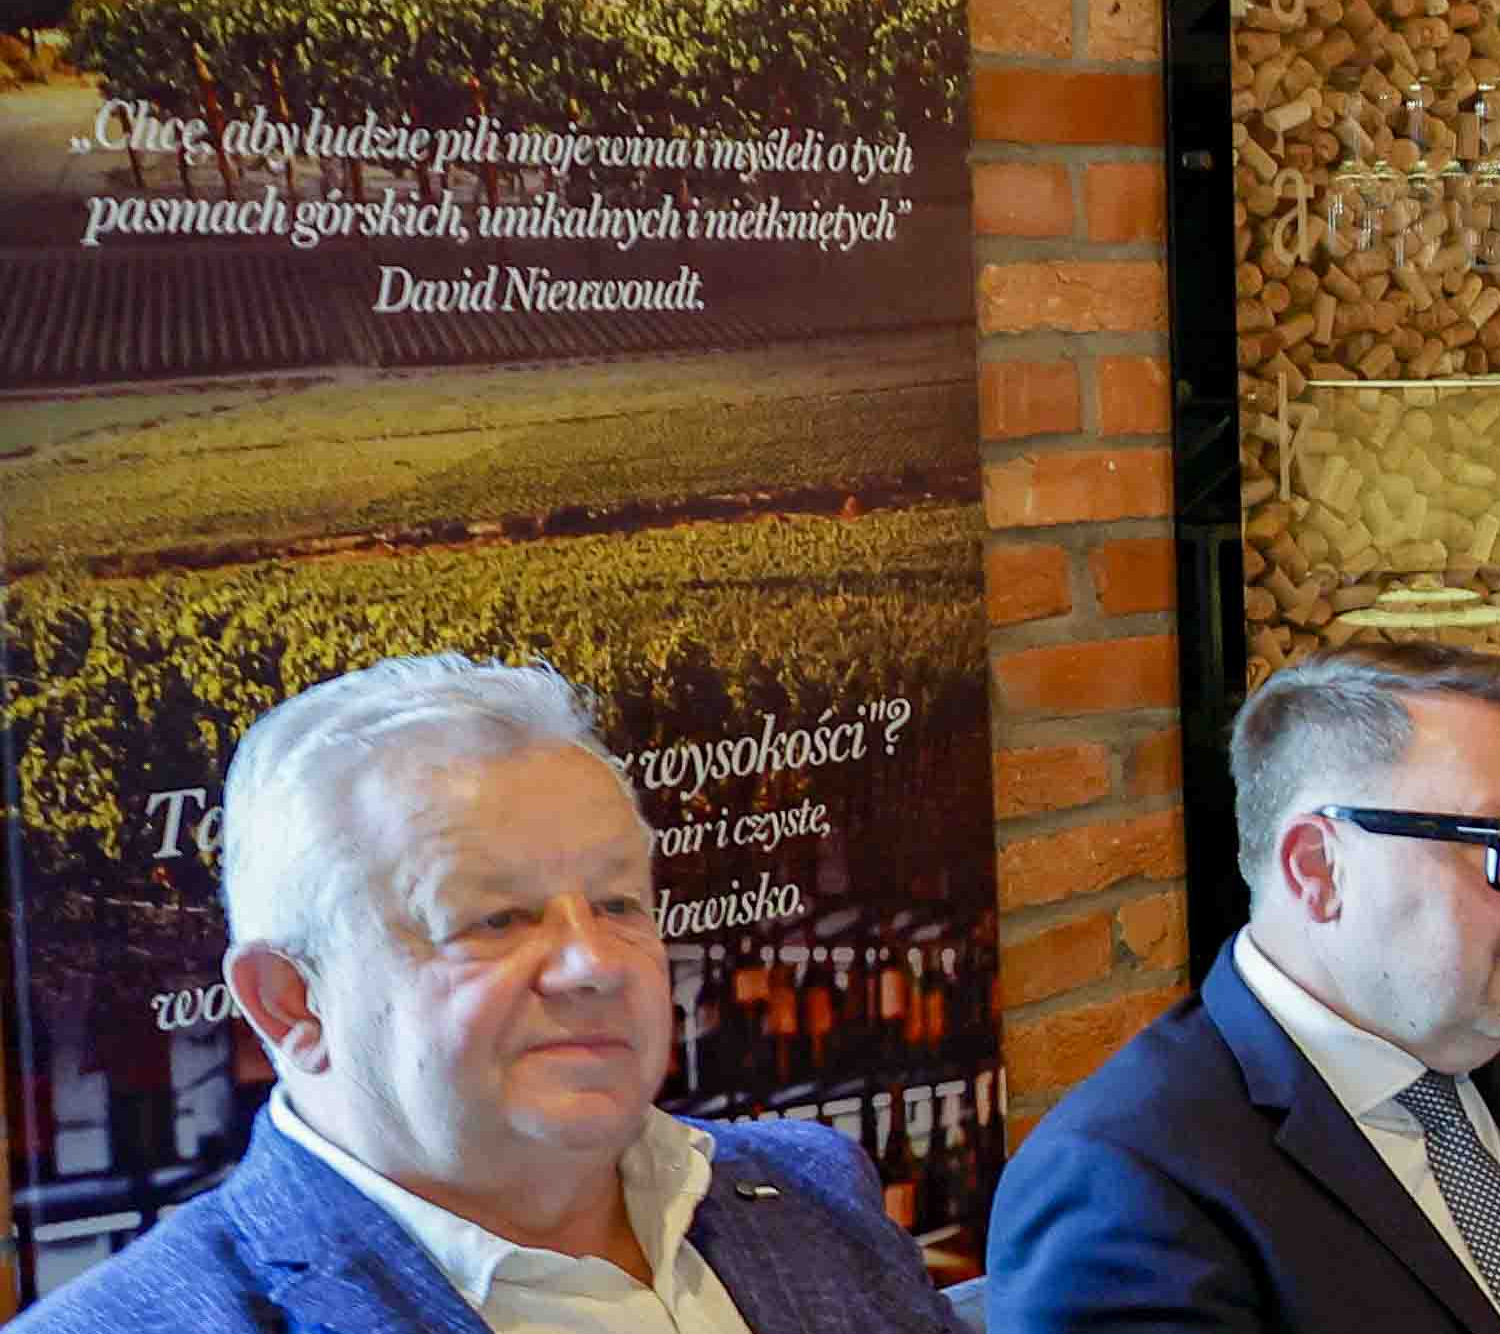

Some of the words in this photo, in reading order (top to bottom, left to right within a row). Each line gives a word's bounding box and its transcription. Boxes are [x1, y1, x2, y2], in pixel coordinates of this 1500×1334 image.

[222, 105, 299, 172] aby
[306, 106, 431, 163] ludzie
[432, 113, 500, 173] pili
[505, 122, 599, 177] moje
[600, 125, 688, 168] wina
[693, 127, 707, 168] i
[710, 128, 826, 182] myśleli
[827, 143, 848, 173] o
[849, 131, 914, 185] tych
[80, 185, 290, 247] pasmach
[290, 186, 470, 249] górskich,
[477, 192, 682, 251] unikalnych
[686, 198, 700, 240] i
[372, 264, 499, 314] David
[500, 266, 706, 314] Nieuwoudt.
[718, 807, 730, 849] i
[733, 798, 832, 852] czyste,
